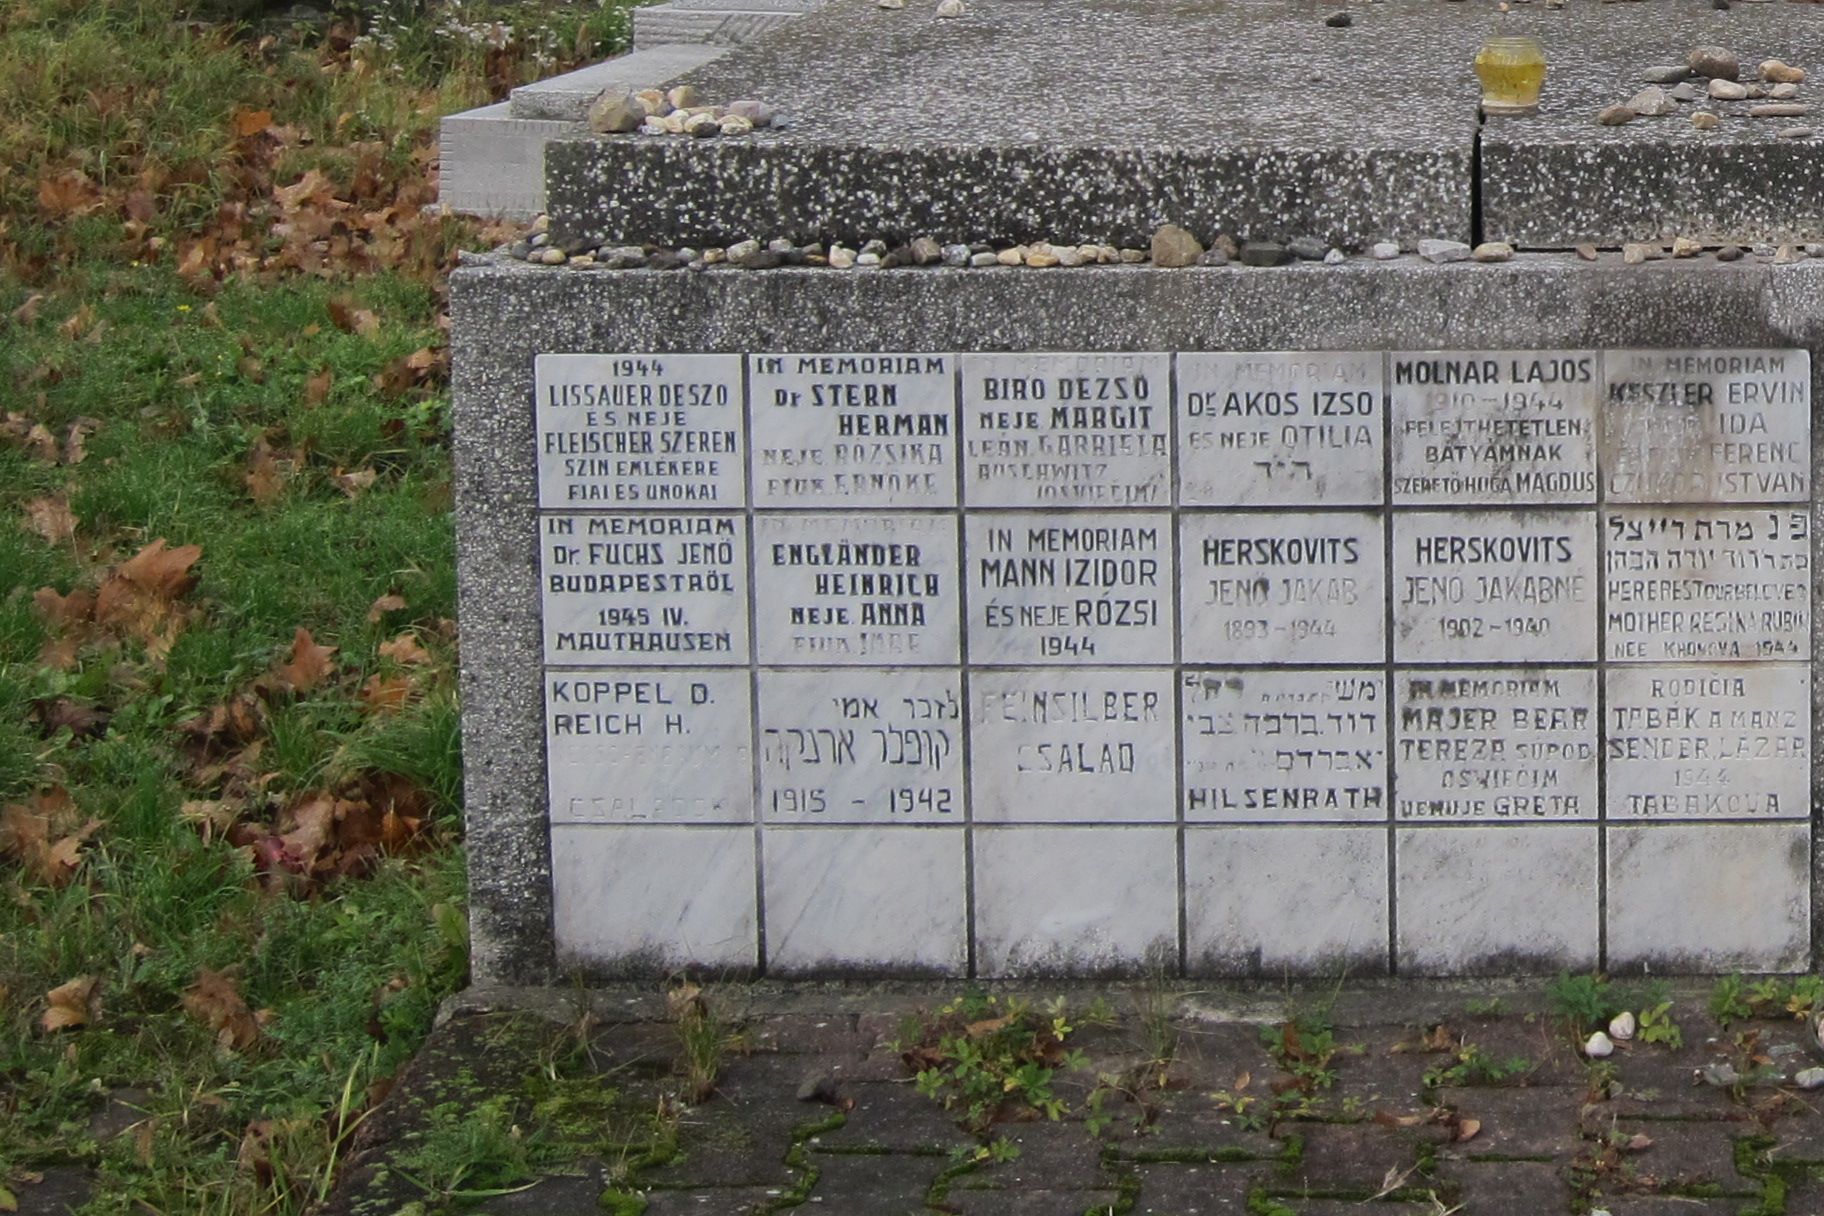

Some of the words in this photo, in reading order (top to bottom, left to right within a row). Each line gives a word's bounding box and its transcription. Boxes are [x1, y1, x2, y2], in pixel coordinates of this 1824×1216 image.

[613, 361, 663, 376] 1944
[757, 358, 783, 374] IN
[797, 358, 944, 374] MEMORIAM
[1512, 360, 1590, 383] LAJOS
[549, 385, 652, 407] LISSAUER
[812, 384, 896, 407] STERN
[838, 414, 948, 436] HERMAN
[545, 432, 652, 454] FLEISCHER
[548, 519, 573, 534] IN
[588, 519, 735, 534] MEMORIAM
[989, 529, 1012, 552] IN
[1028, 528, 1157, 552] MEMORIAM
[1203, 537, 1359, 565] HERSKOVITS
[1416, 537, 1571, 564] HERSKOVITS
[588, 544, 663, 565] FUCHS
[772, 539, 921, 565] ENGLÄNDER
[981, 559, 1054, 587] MANN
[1065, 559, 1157, 586] IZIDOR
[816, 574, 938, 596] HEINRICH
[600, 608, 649, 625] 1945
[663, 608, 688, 625] IV.
[556, 633, 730, 651] MAUTHAUSEN
[1040, 637, 1094, 656] 1944
[552, 683, 672, 704] KOPPEL
[692, 684, 715, 704] D.
[833, 698, 879, 718] אמי
[555, 714, 642, 735] REICH
[666, 714, 690, 734] H.
[1188, 787, 1381, 810] HILSENRATH
